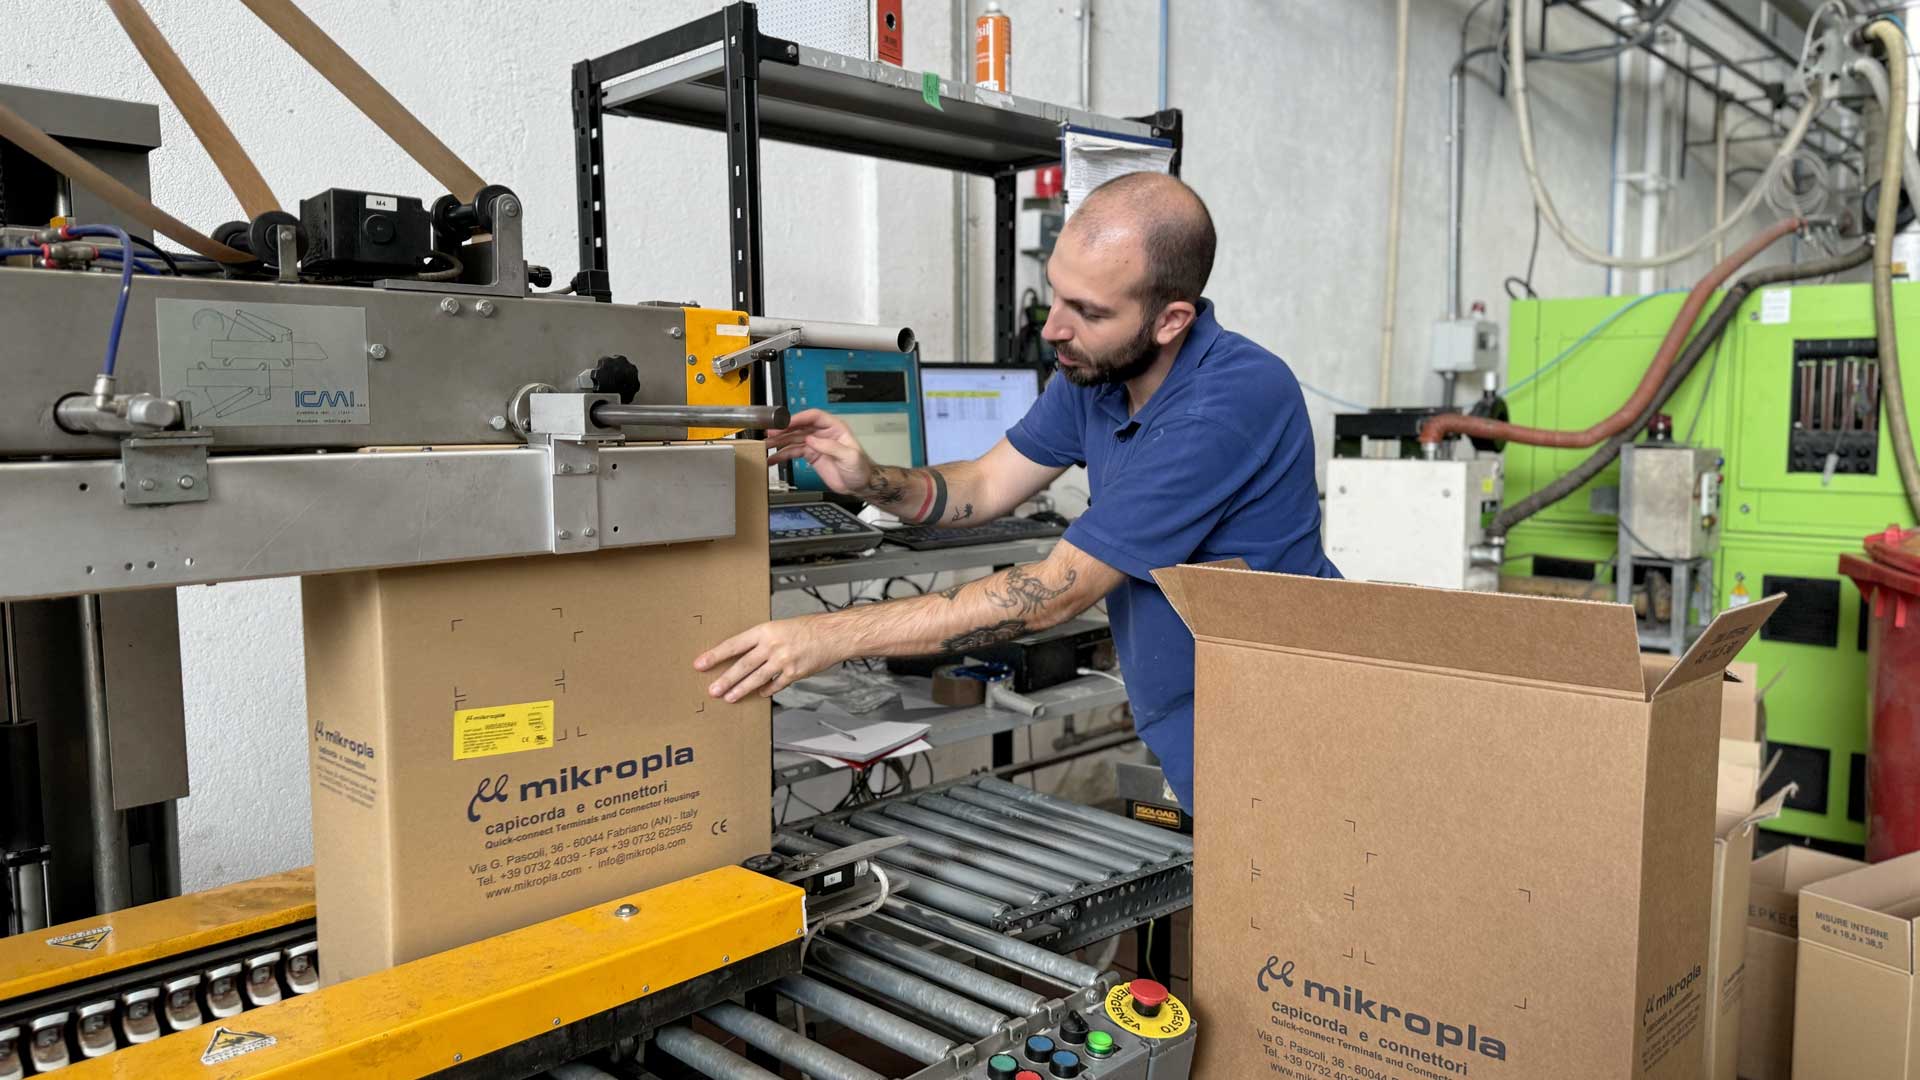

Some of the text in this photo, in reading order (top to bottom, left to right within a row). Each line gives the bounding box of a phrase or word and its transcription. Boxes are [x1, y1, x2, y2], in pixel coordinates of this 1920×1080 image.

[295, 390, 354, 408] ICMI
[325, 730, 375, 759] mikropla
[520, 744, 694, 802] mikropla
[485, 780, 668, 836] capicorda e connettori
[485, 790, 700, 850] Quick-connect Terminals and Connector Housings
[469, 863, 487, 876] Via
[490, 858, 503, 870] G.
[506, 847, 549, 866] Pascoli,
[551, 842, 564, 855] 36
[573, 833, 604, 849] 60044
[606, 821, 649, 841] Fabriano
[651, 815, 672, 830] (AN)
[680, 807, 699, 821] Italy
[476, 875, 497, 888] Tel.
[501, 867, 521, 881] +39
[524, 859, 551, 877] 0732
[554, 851, 580, 867] 4039
[589, 845, 609, 858] Fax
[612, 838, 630, 851] +39
[631, 830, 656, 846] 0732
[658, 821, 694, 839] 625955
[485, 866, 583, 900] www.mikropla.com
[598, 837, 687, 869] info@mikropla.com
[1815, 911, 1889, 941] MISURE INTERNE
[1656, 961, 1701, 1011] mikropla
[1256, 1028, 1273, 1043] Via
[1275, 1036, 1287, 1048] G.
[1289, 1040, 1328, 1065] Pascoli,
[1331, 1056, 1345, 1069] 36
[1271, 1001, 1468, 1076] capicorda e connettori
[1271, 1015, 1453, 1080] Quick-connect Terminals and Connect
[1304, 979, 1507, 1062] mikropla
[1263, 1043, 1280, 1059] Tel.
[1283, 1053, 1303, 1067] +39
[1305, 1060, 1331, 1078] 0732
